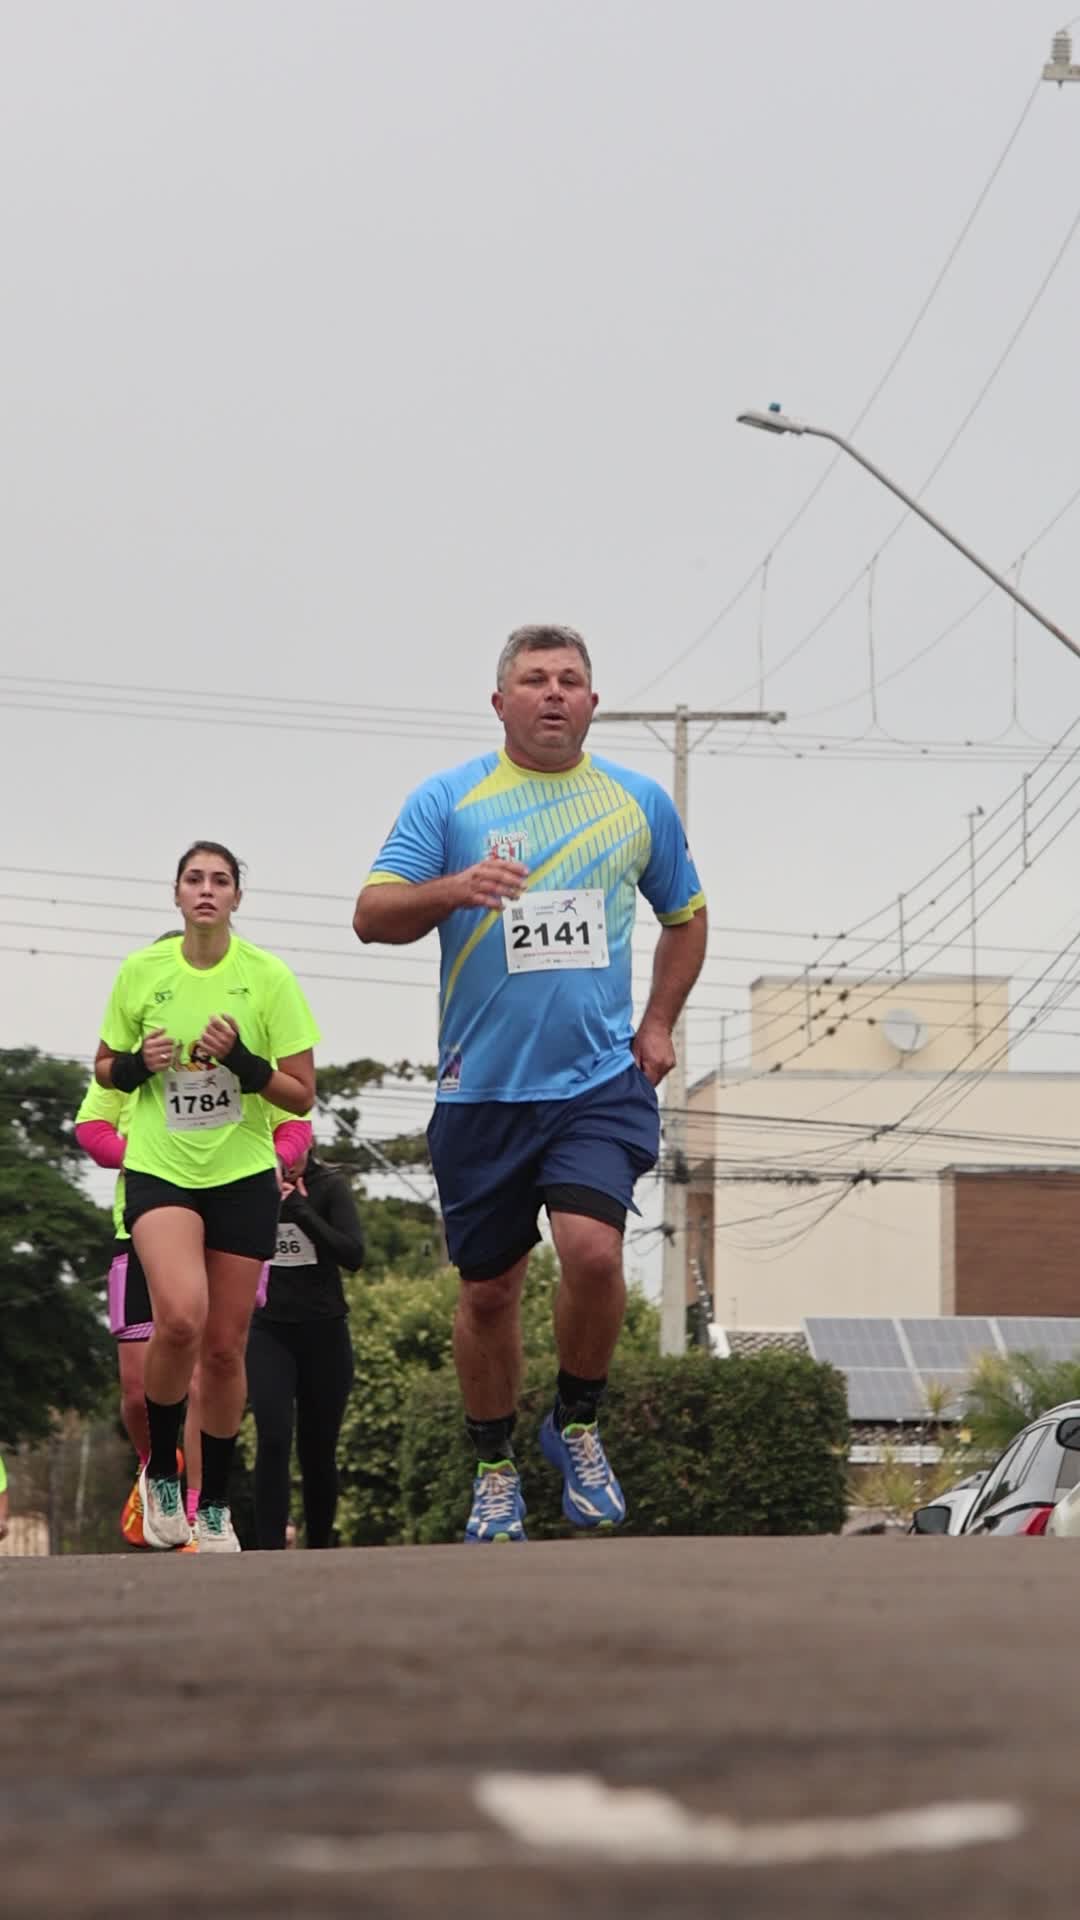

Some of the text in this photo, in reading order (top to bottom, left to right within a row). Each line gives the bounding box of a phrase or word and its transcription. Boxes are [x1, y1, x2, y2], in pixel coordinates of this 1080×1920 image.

[512, 921, 590, 950] 2141
[170, 1090, 231, 1114] 1784
[275, 1240, 301, 1254] 86
